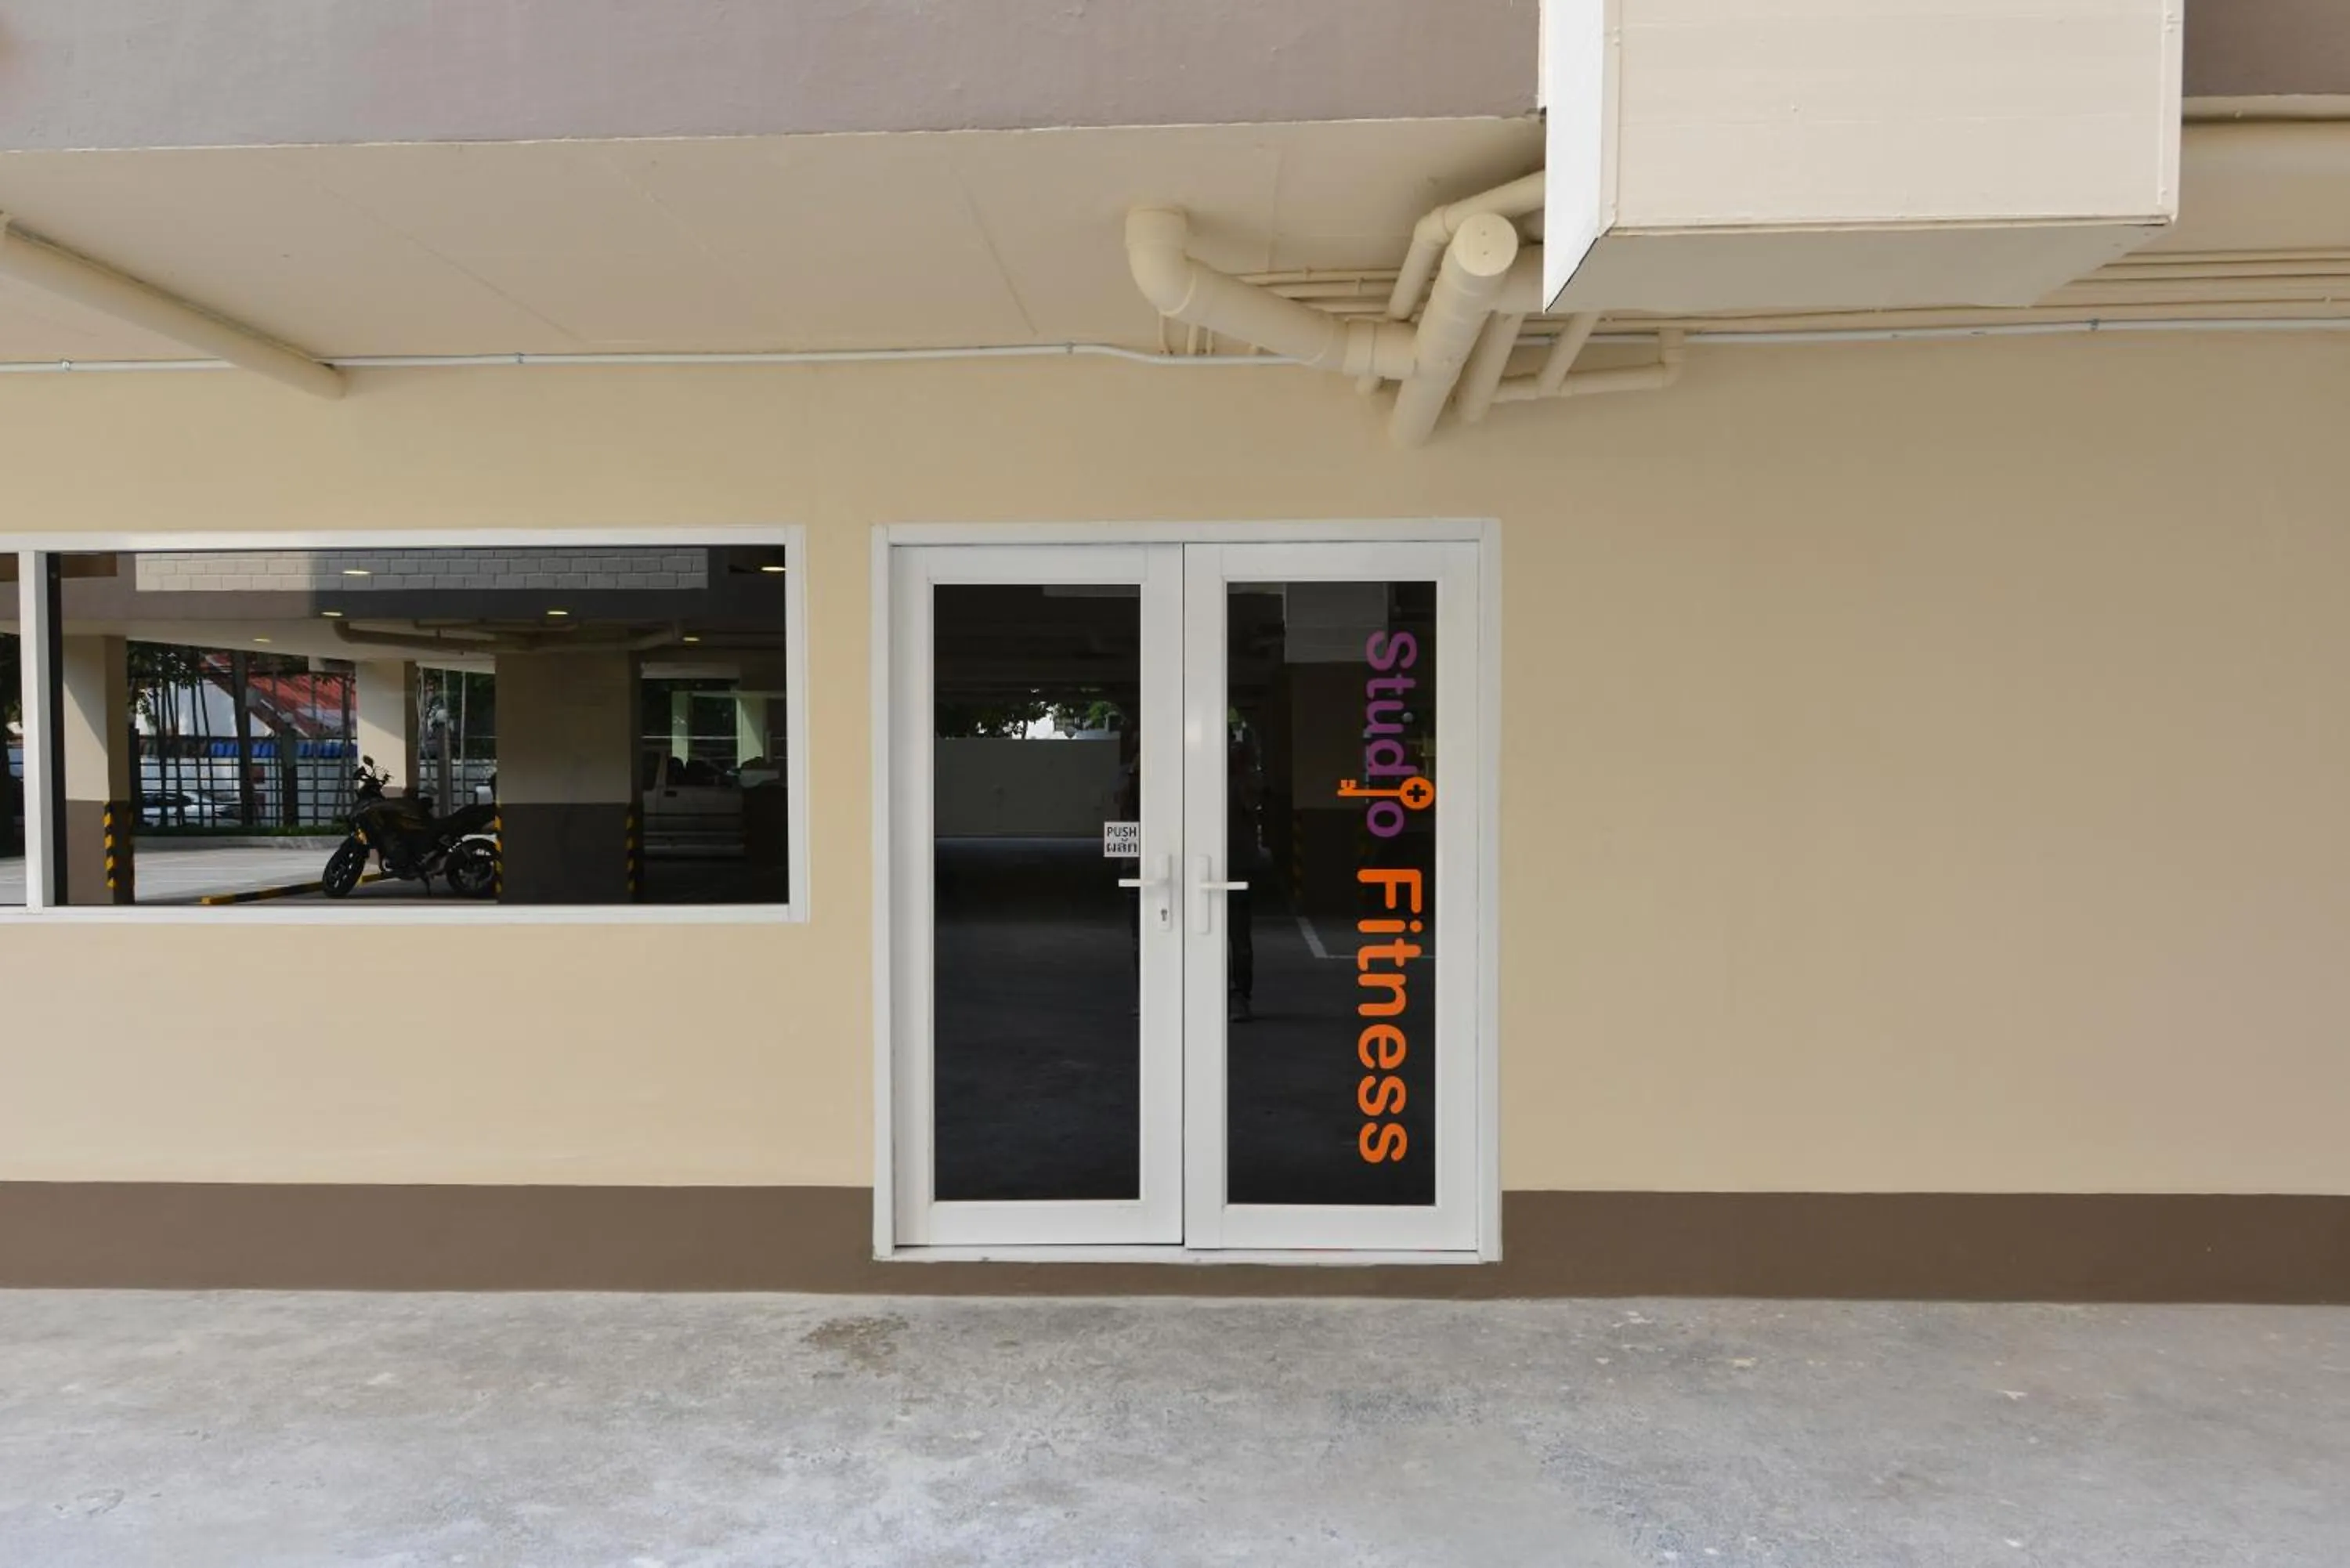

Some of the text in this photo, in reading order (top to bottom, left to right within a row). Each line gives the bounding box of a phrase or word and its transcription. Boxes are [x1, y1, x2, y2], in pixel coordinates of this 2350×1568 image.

[1107, 826, 1137, 837] PUSH
[1106, 837, 1137, 853] ผลัก
[1358, 869, 1423, 1163] Fitness
